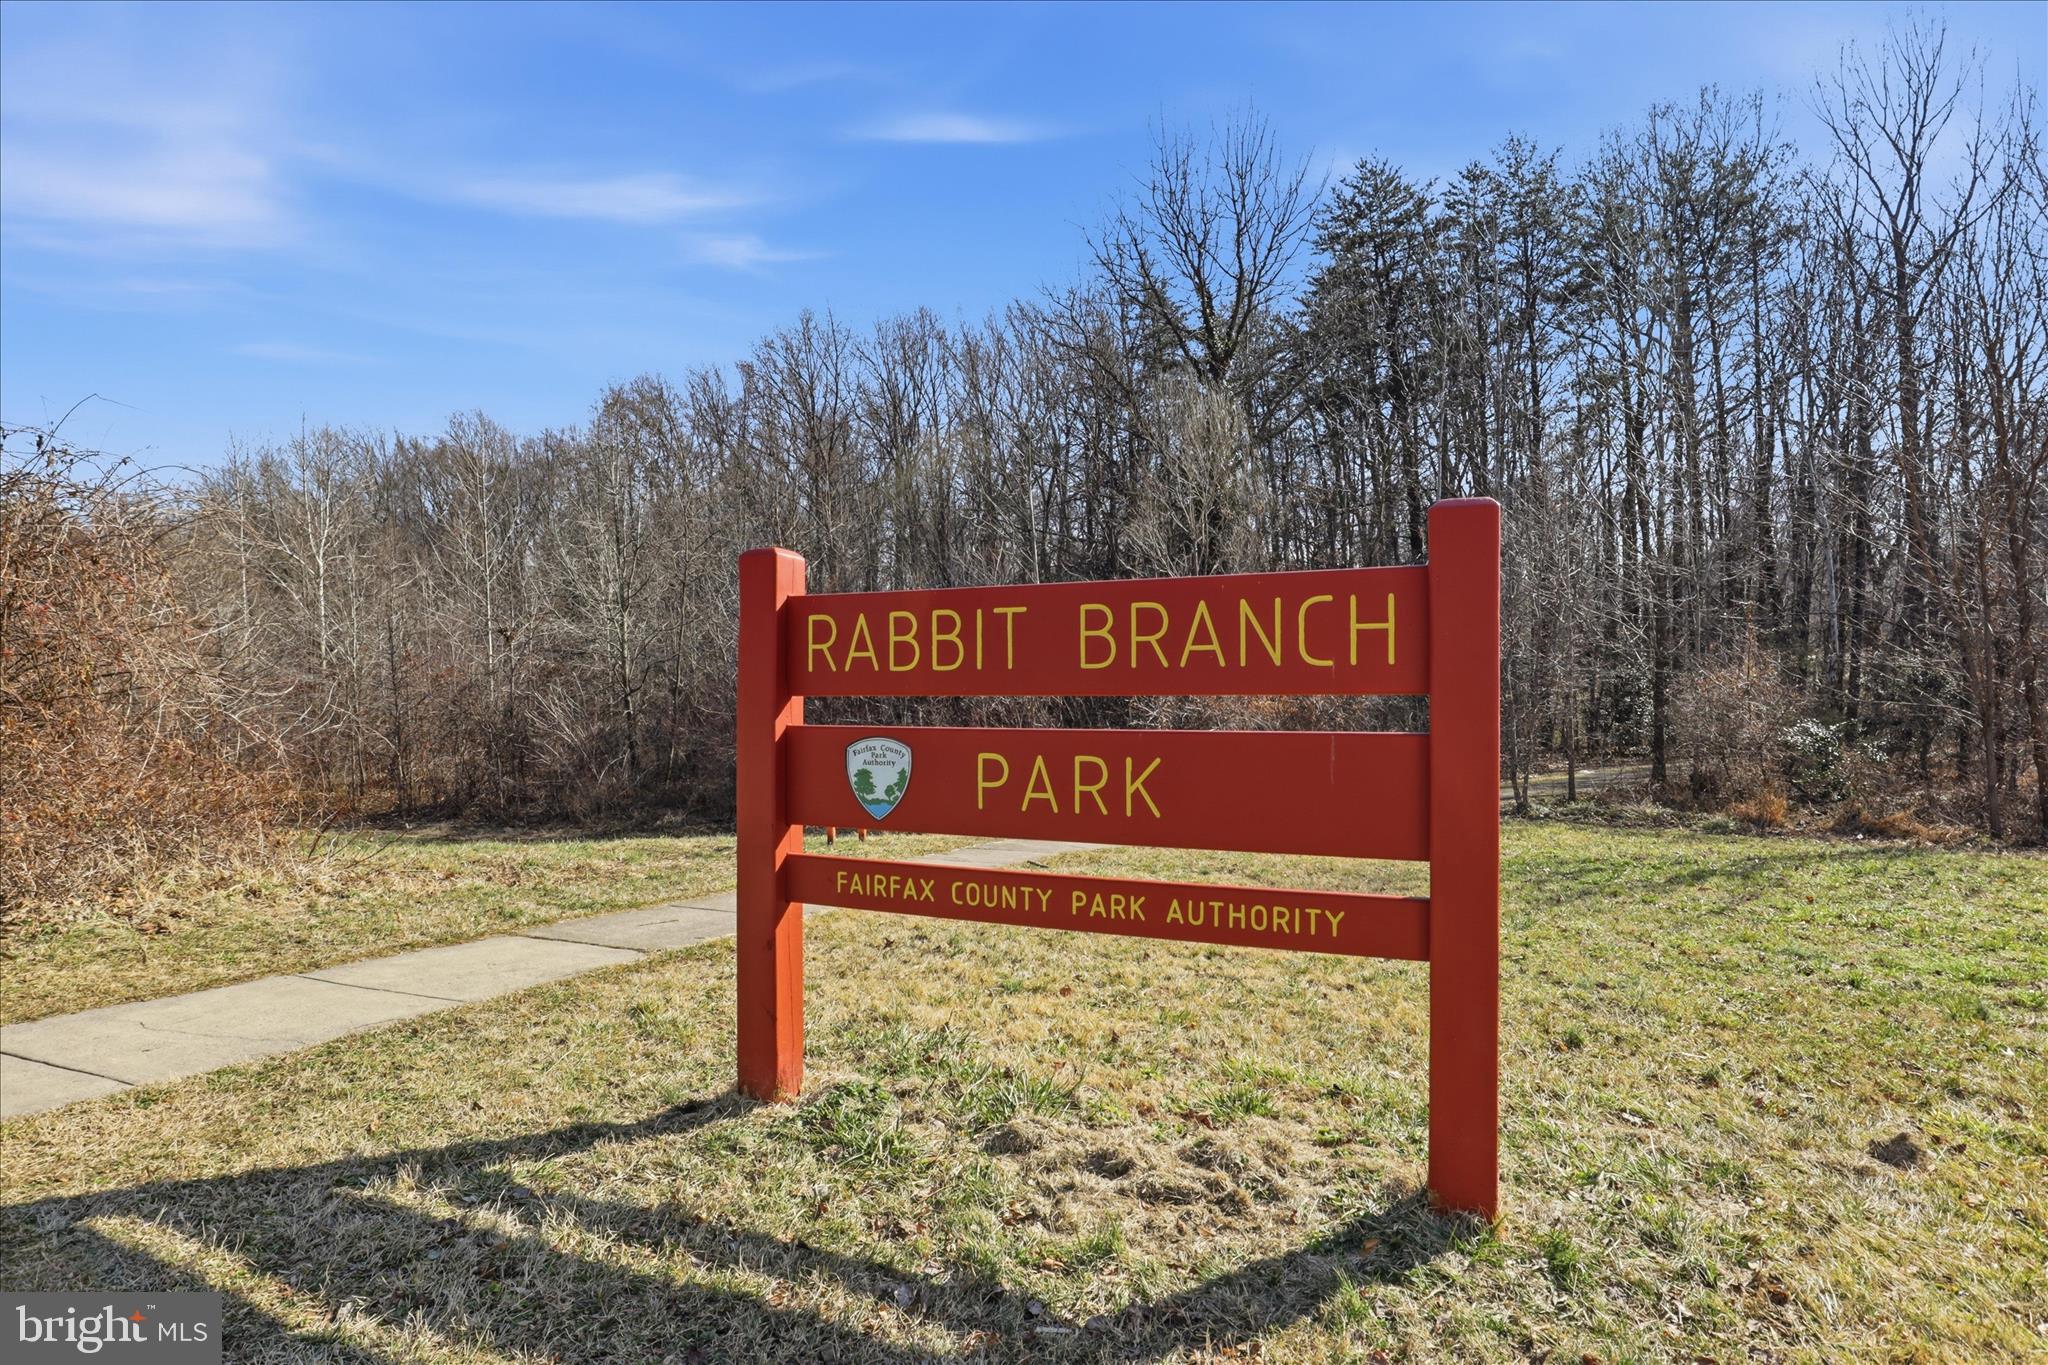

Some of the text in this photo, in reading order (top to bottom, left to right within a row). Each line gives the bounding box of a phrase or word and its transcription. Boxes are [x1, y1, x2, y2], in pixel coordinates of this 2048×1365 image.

[807, 592, 1397, 673] RABBIT BRANCH
[852, 744, 906, 759] Fairfax County
[862, 759, 897, 768] Authority
[871, 751, 887, 759] Park
[976, 751, 1162, 819] PARK
[836, 871, 1345, 937] FAIRFAX COUNTY PARK AUTHORITY
